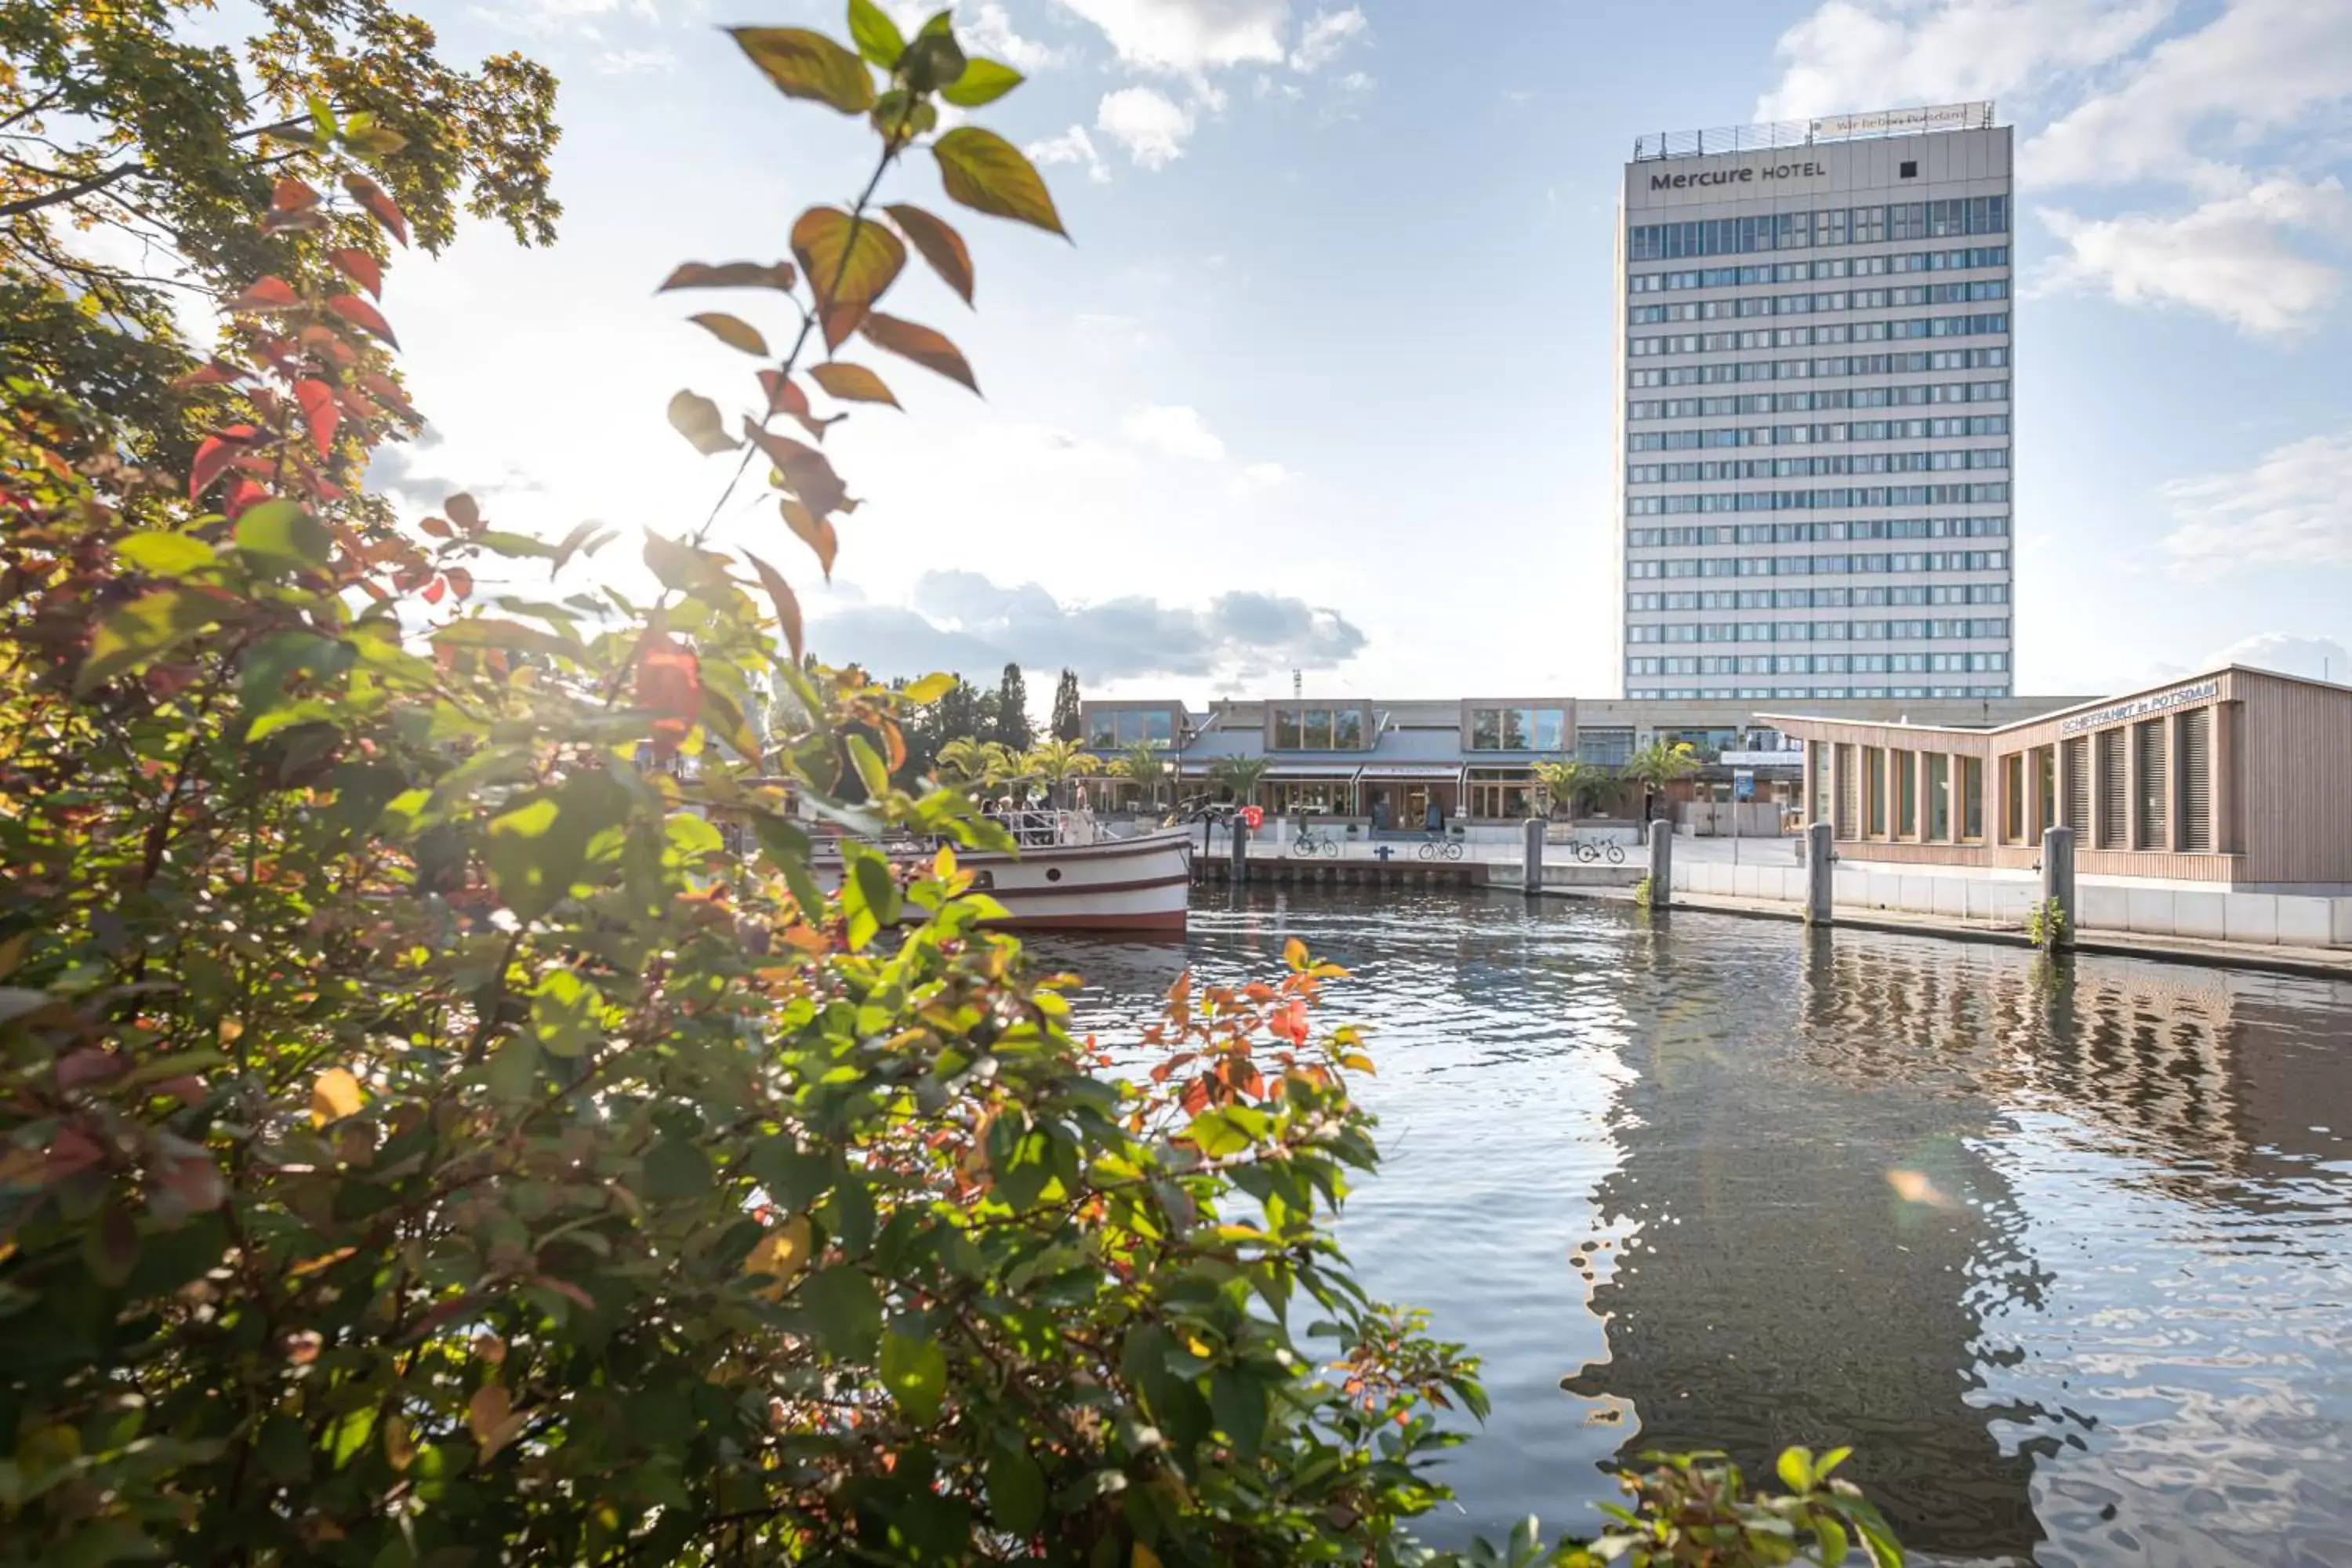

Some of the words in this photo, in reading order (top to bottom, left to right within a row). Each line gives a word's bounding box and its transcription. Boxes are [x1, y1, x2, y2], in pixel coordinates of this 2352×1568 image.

[1650, 167, 1753, 191] Mercure
[1762, 162, 1826, 180] HOTEL
[2138, 702, 2148, 713] in
[2151, 682, 2215, 708] POTSDAM
